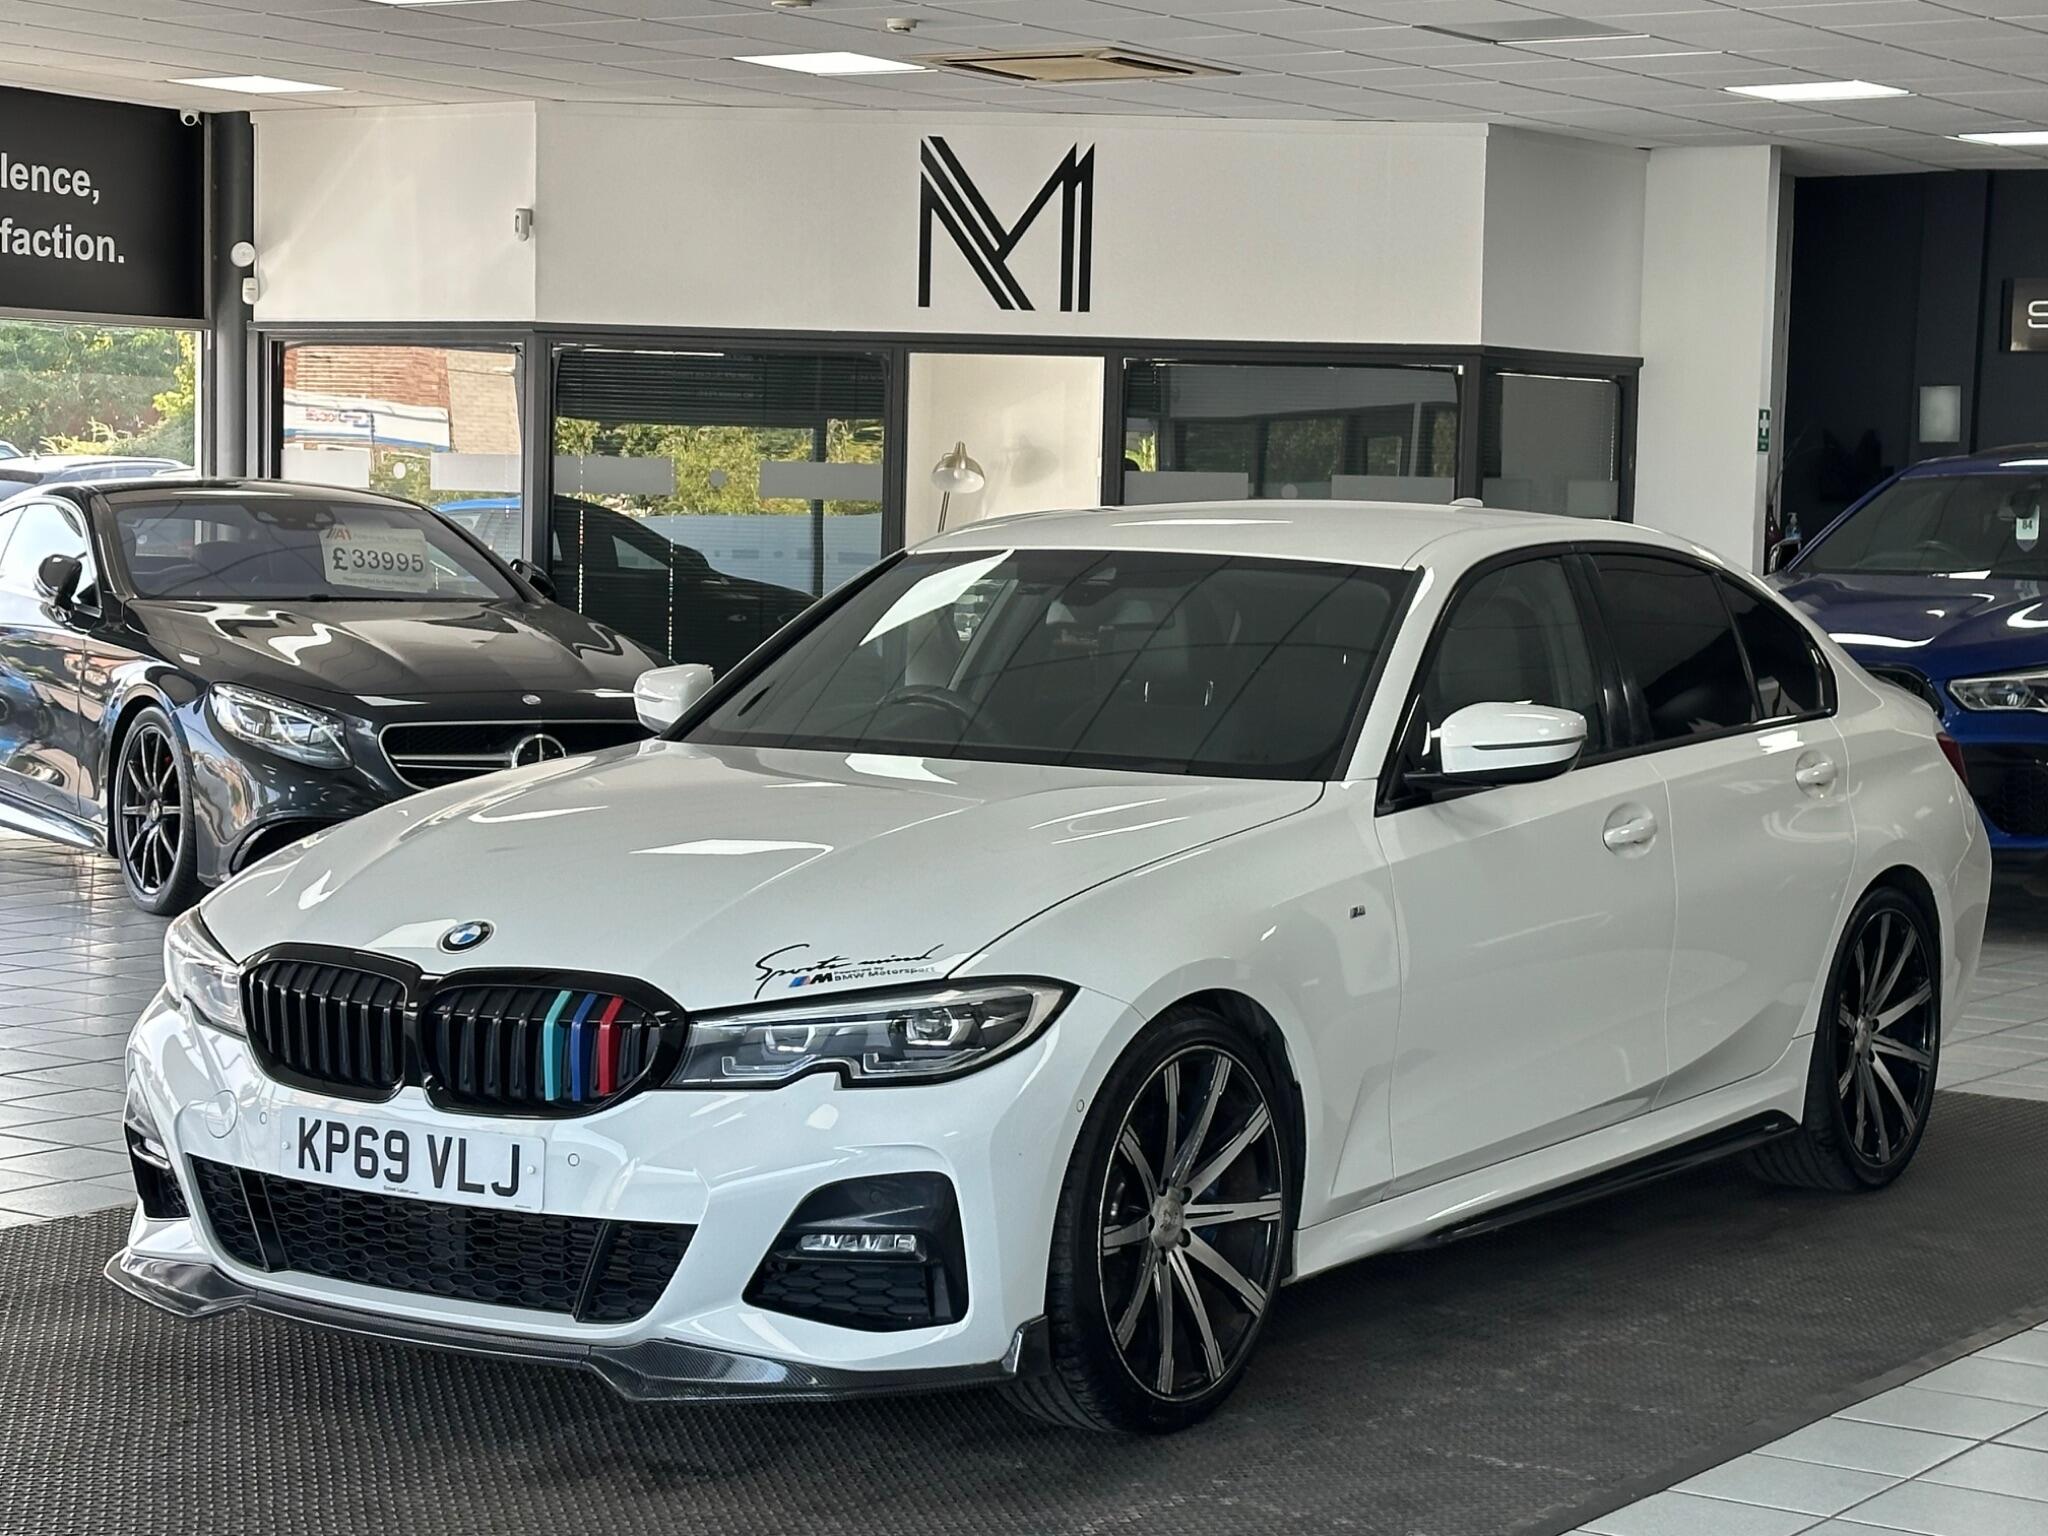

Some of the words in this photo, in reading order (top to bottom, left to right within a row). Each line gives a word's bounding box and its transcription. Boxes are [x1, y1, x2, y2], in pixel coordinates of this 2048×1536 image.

[0, 152, 100, 204] lence,
[0, 217, 125, 263] faction.
[332, 547, 424, 573] £33995
[834, 972, 865, 982] BMW
[868, 966, 936, 978] Motorsport
[298, 1116, 410, 1184] KP69
[427, 1134, 521, 1198] VLJ
